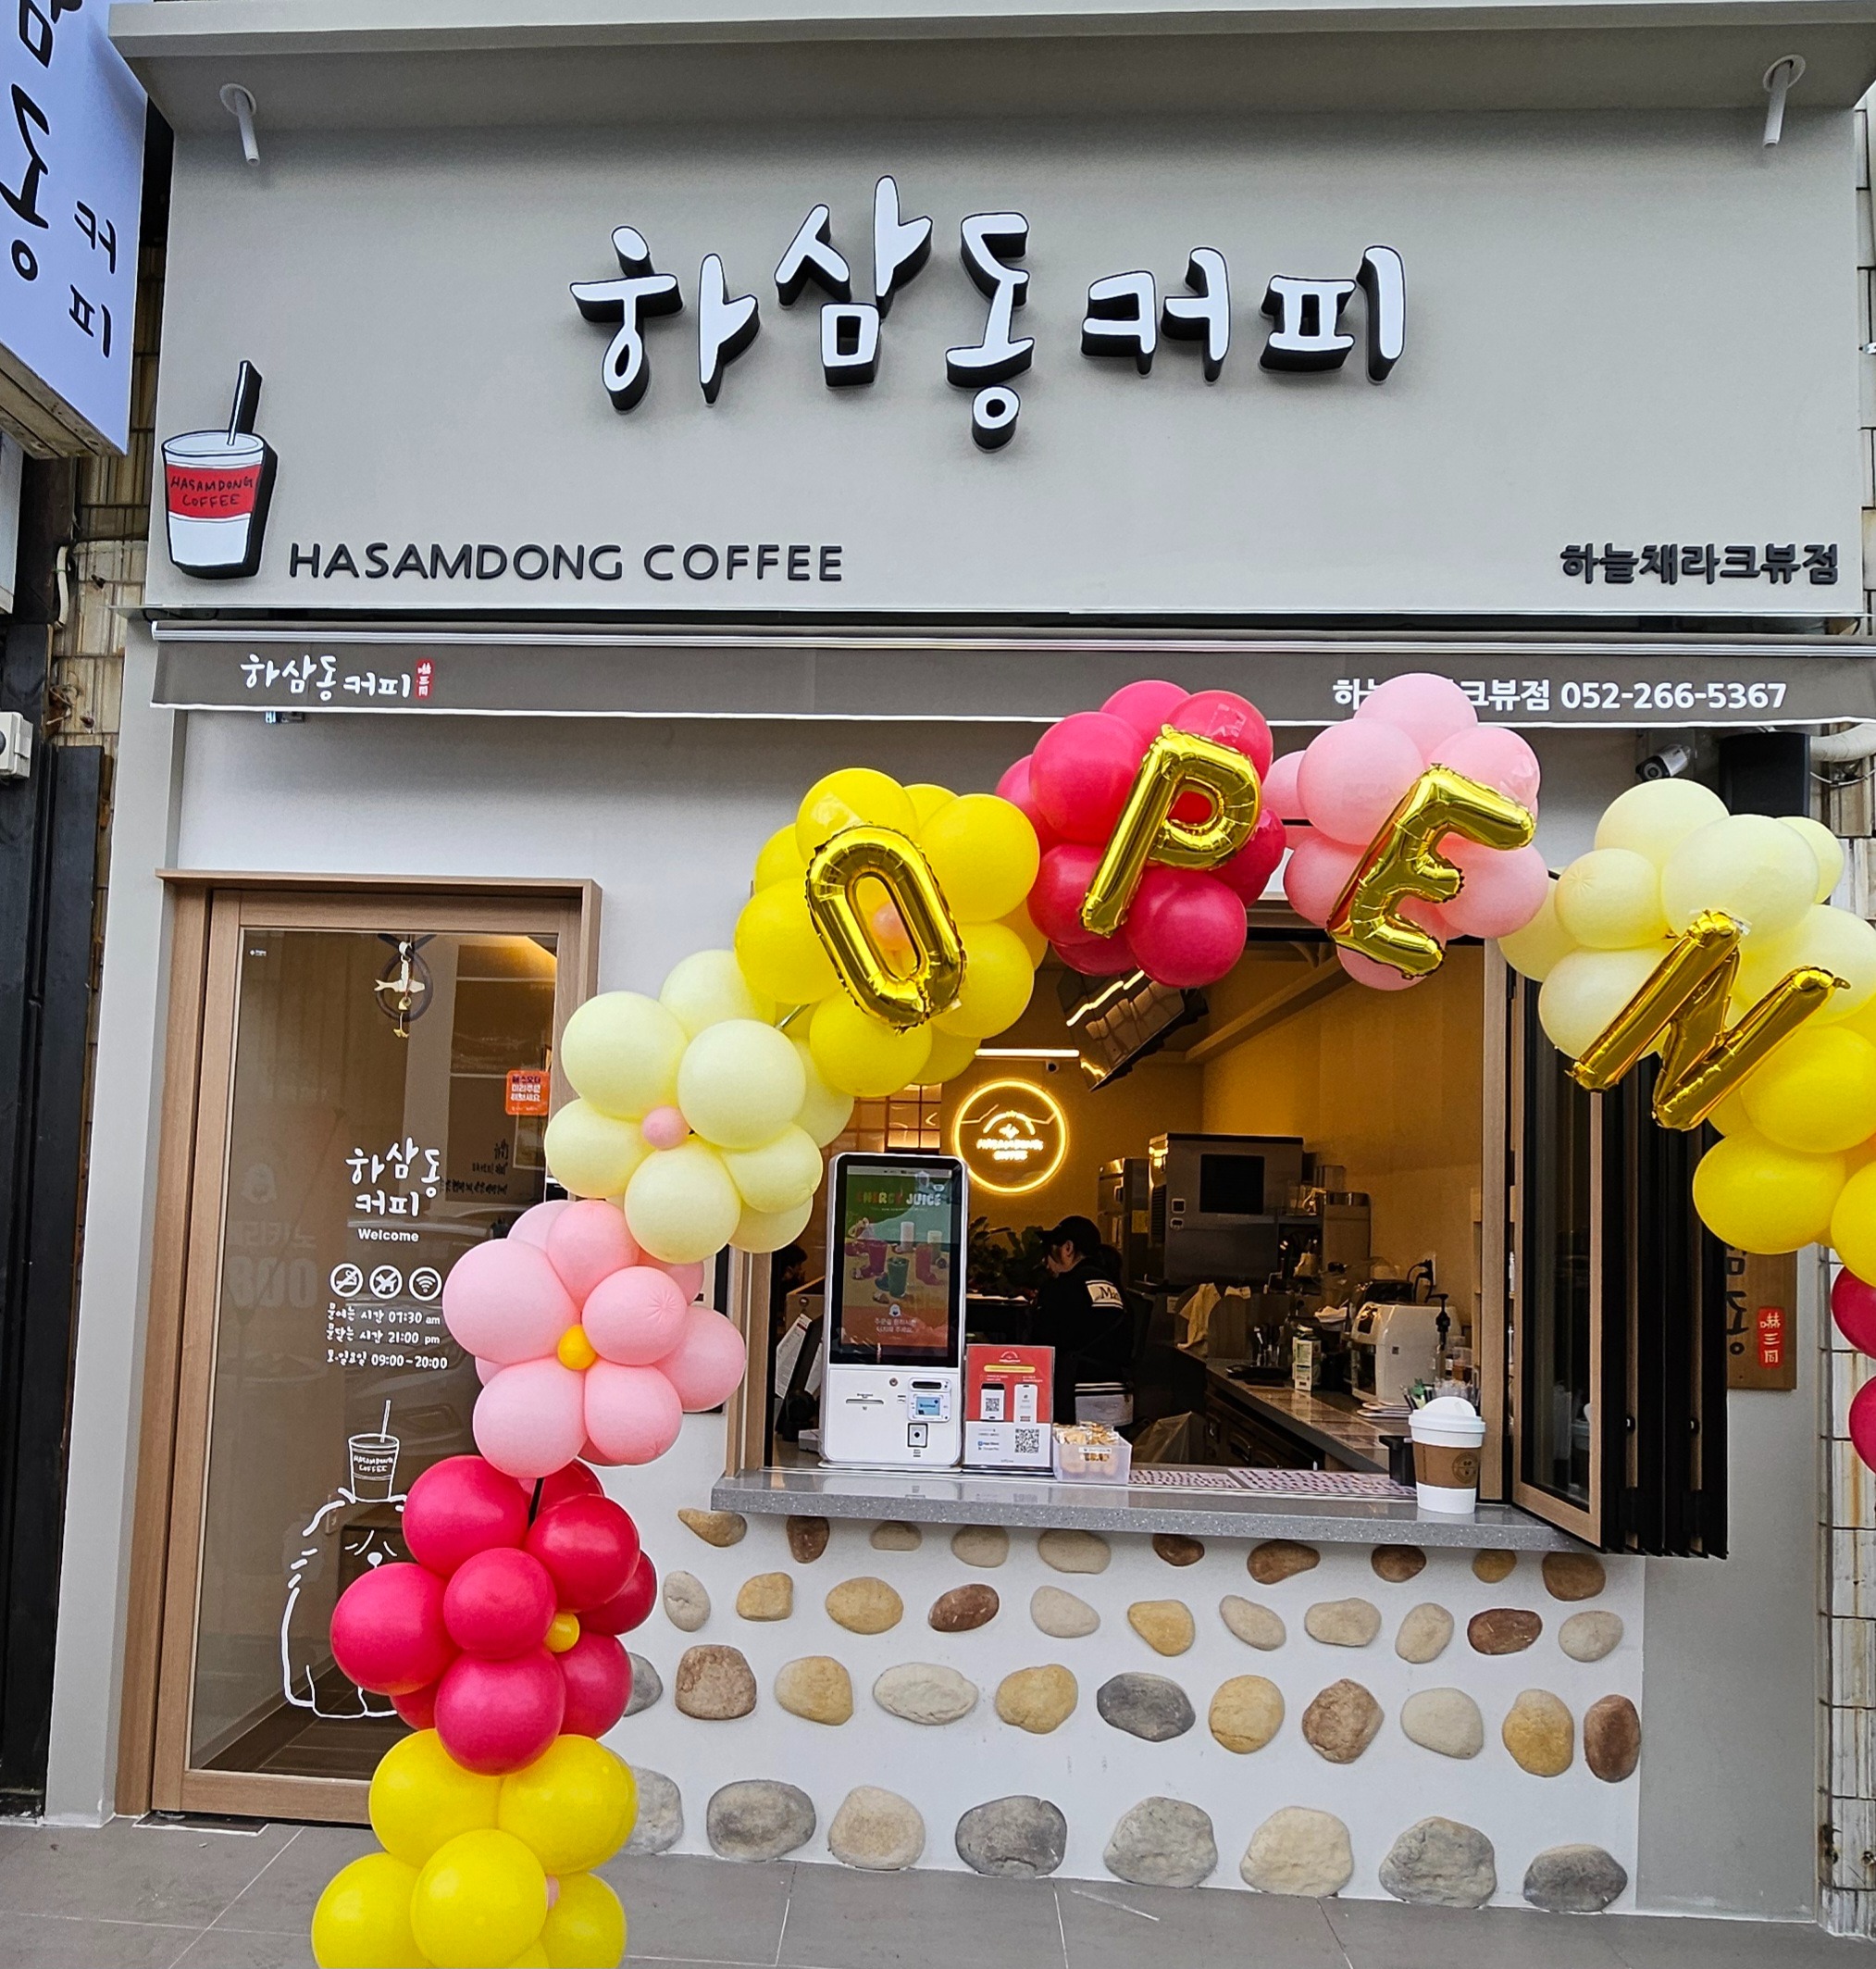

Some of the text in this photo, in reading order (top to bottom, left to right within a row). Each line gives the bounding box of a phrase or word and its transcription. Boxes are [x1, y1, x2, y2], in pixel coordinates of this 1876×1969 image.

[69, 200, 117, 358] 커피
[169, 475, 254, 492] HASAMDONG
[181, 493, 241, 508] COFFEE
[289, 542, 844, 583] HASAMDONG COFFEE
[1560, 542, 1839, 585] 하늘채라크뷰점
[1332, 678, 1787, 712] 하크뷰점 052-266-5367
[344, 1136, 441, 1198] 하삼동
[354, 1189, 419, 1217] 커피
[906, 1192, 942, 1206] JUICE
[357, 1228, 419, 1242] Welcome
[388, 1311, 423, 1324] 07:30
[425, 1316, 441, 1325] am
[388, 1331, 419, 1344] 21:00
[424, 1336, 441, 1345] pm
